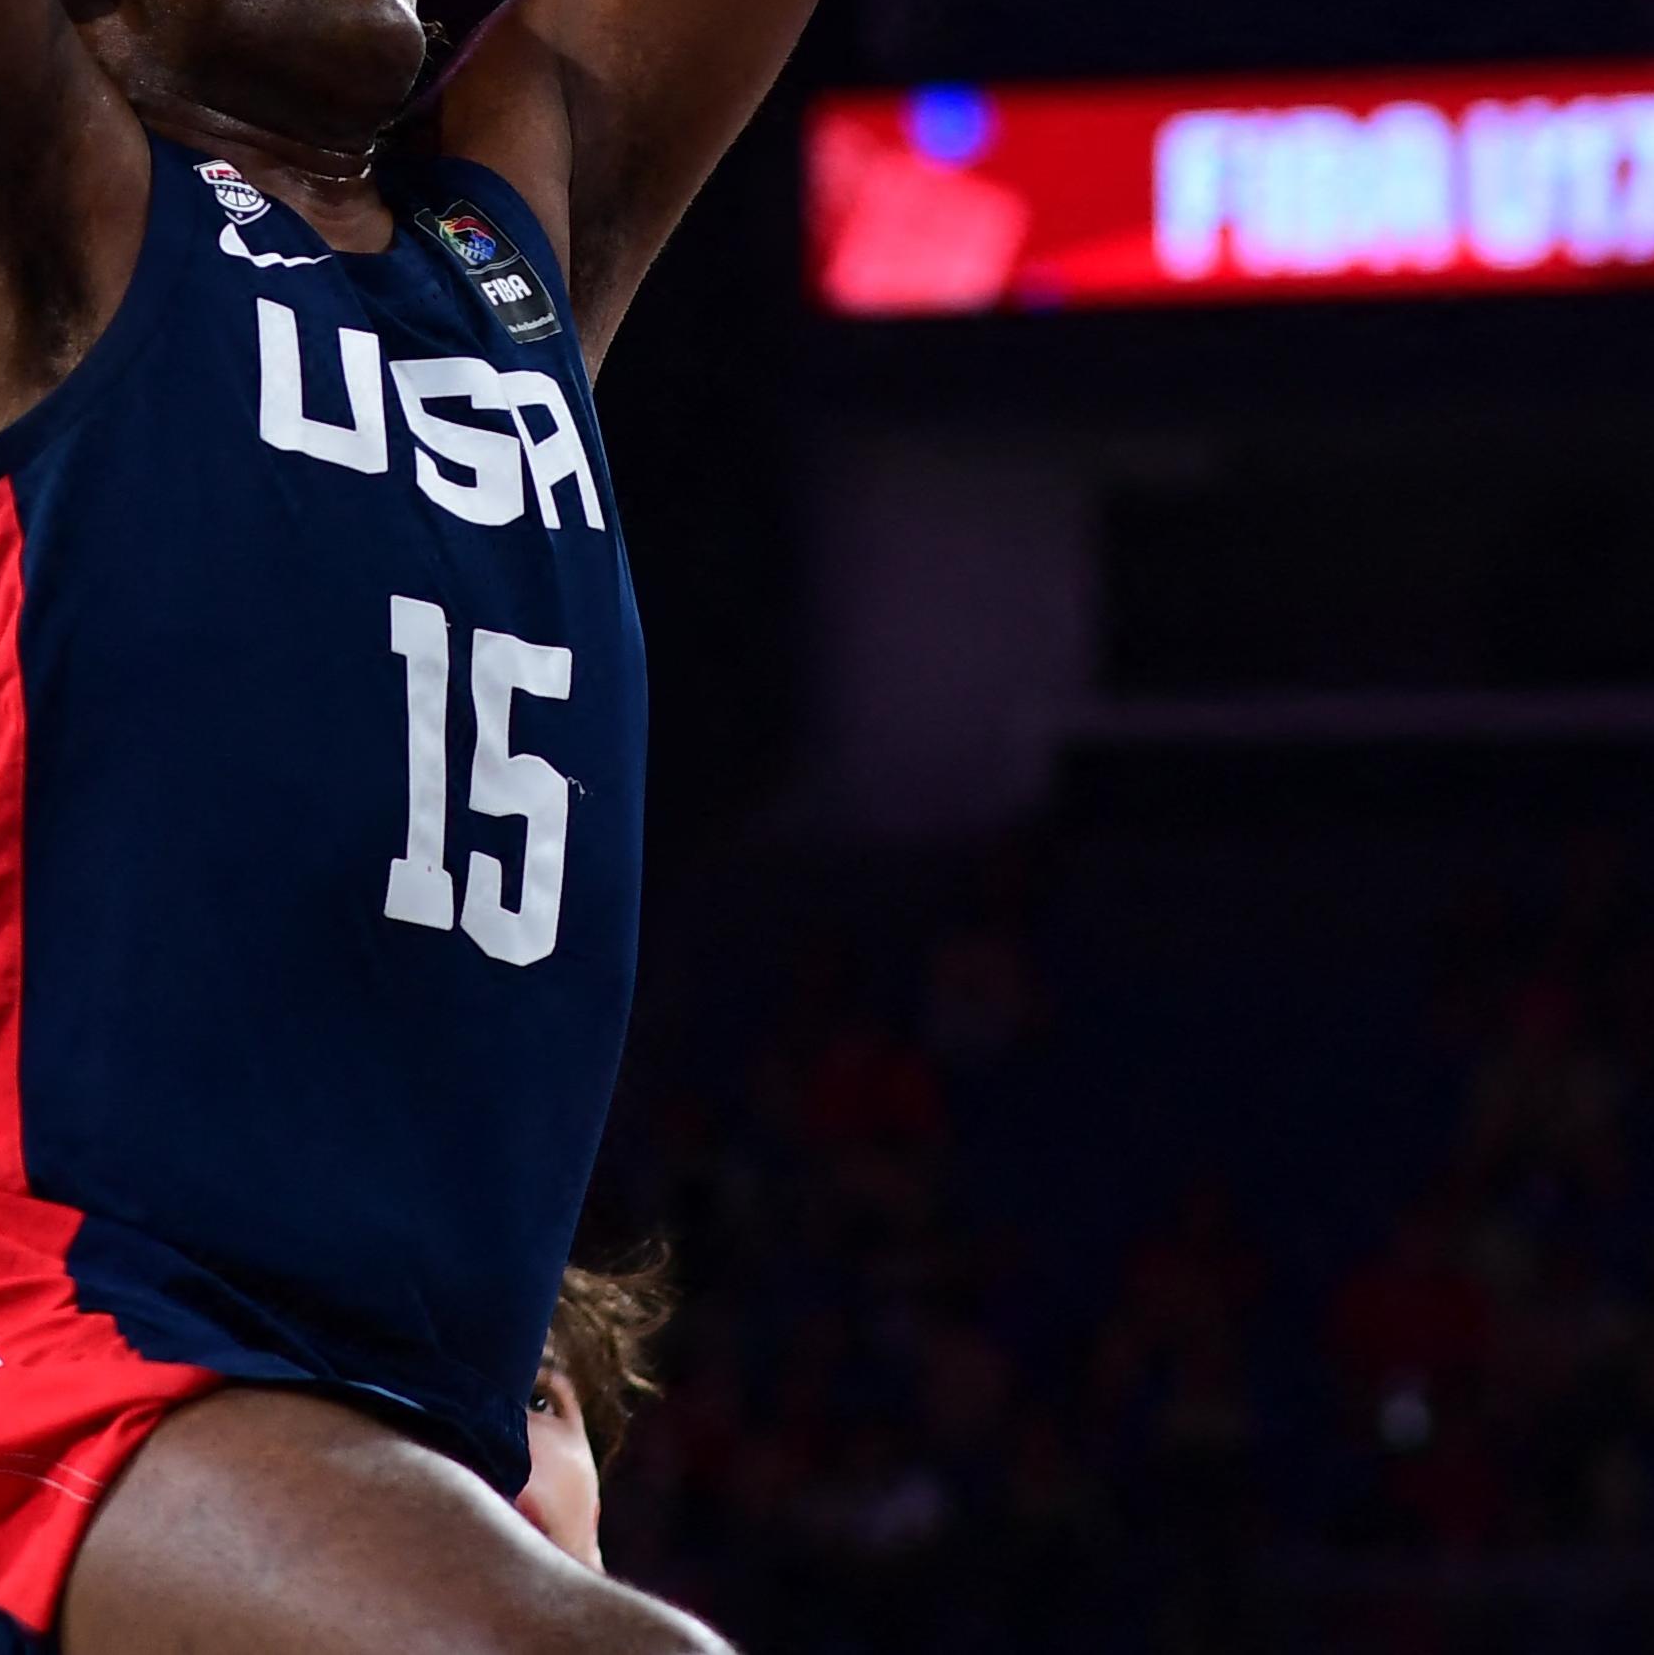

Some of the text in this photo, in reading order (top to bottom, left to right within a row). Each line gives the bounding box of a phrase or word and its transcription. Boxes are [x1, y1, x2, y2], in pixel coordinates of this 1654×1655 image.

[481, 274, 532, 306] FIBA
[1153, 100, 1459, 280] FIBA
[257, 297, 605, 532] USA
[384, 594, 572, 966] 15
